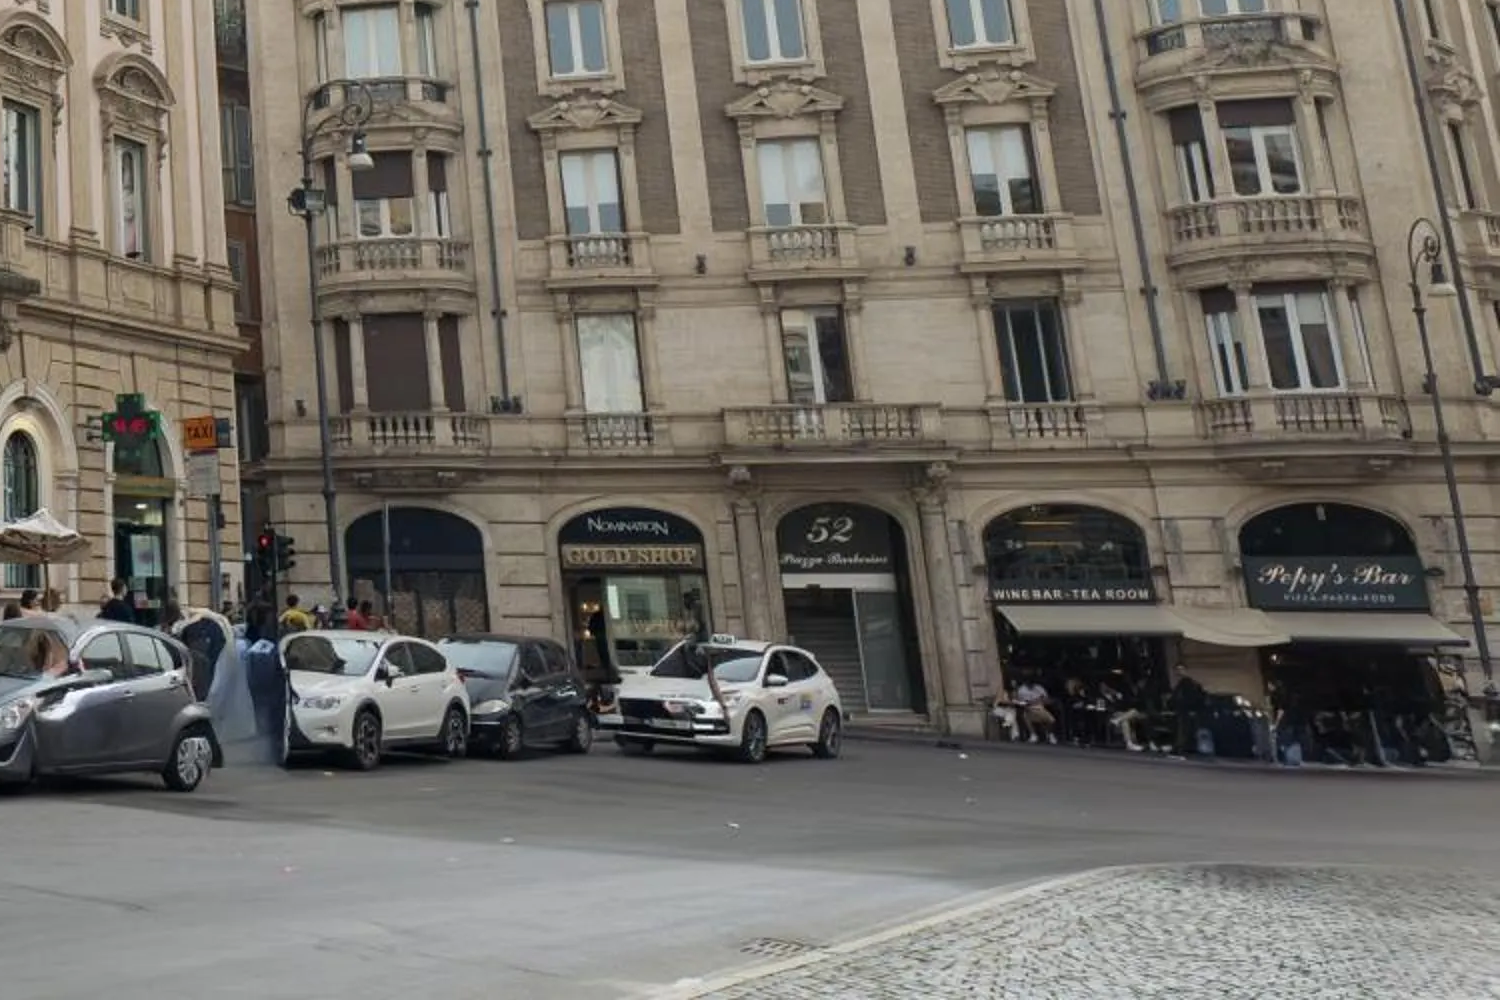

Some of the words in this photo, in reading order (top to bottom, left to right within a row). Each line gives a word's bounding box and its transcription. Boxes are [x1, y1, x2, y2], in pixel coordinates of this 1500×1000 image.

[187, 423, 213, 439] TAXI
[806, 516, 853, 543] 52
[567, 547, 631, 565] GOLD
[637, 547, 696, 565] SHOP
[1352, 563, 1415, 585] Bar
[1104, 588, 1149, 600] ROOM
